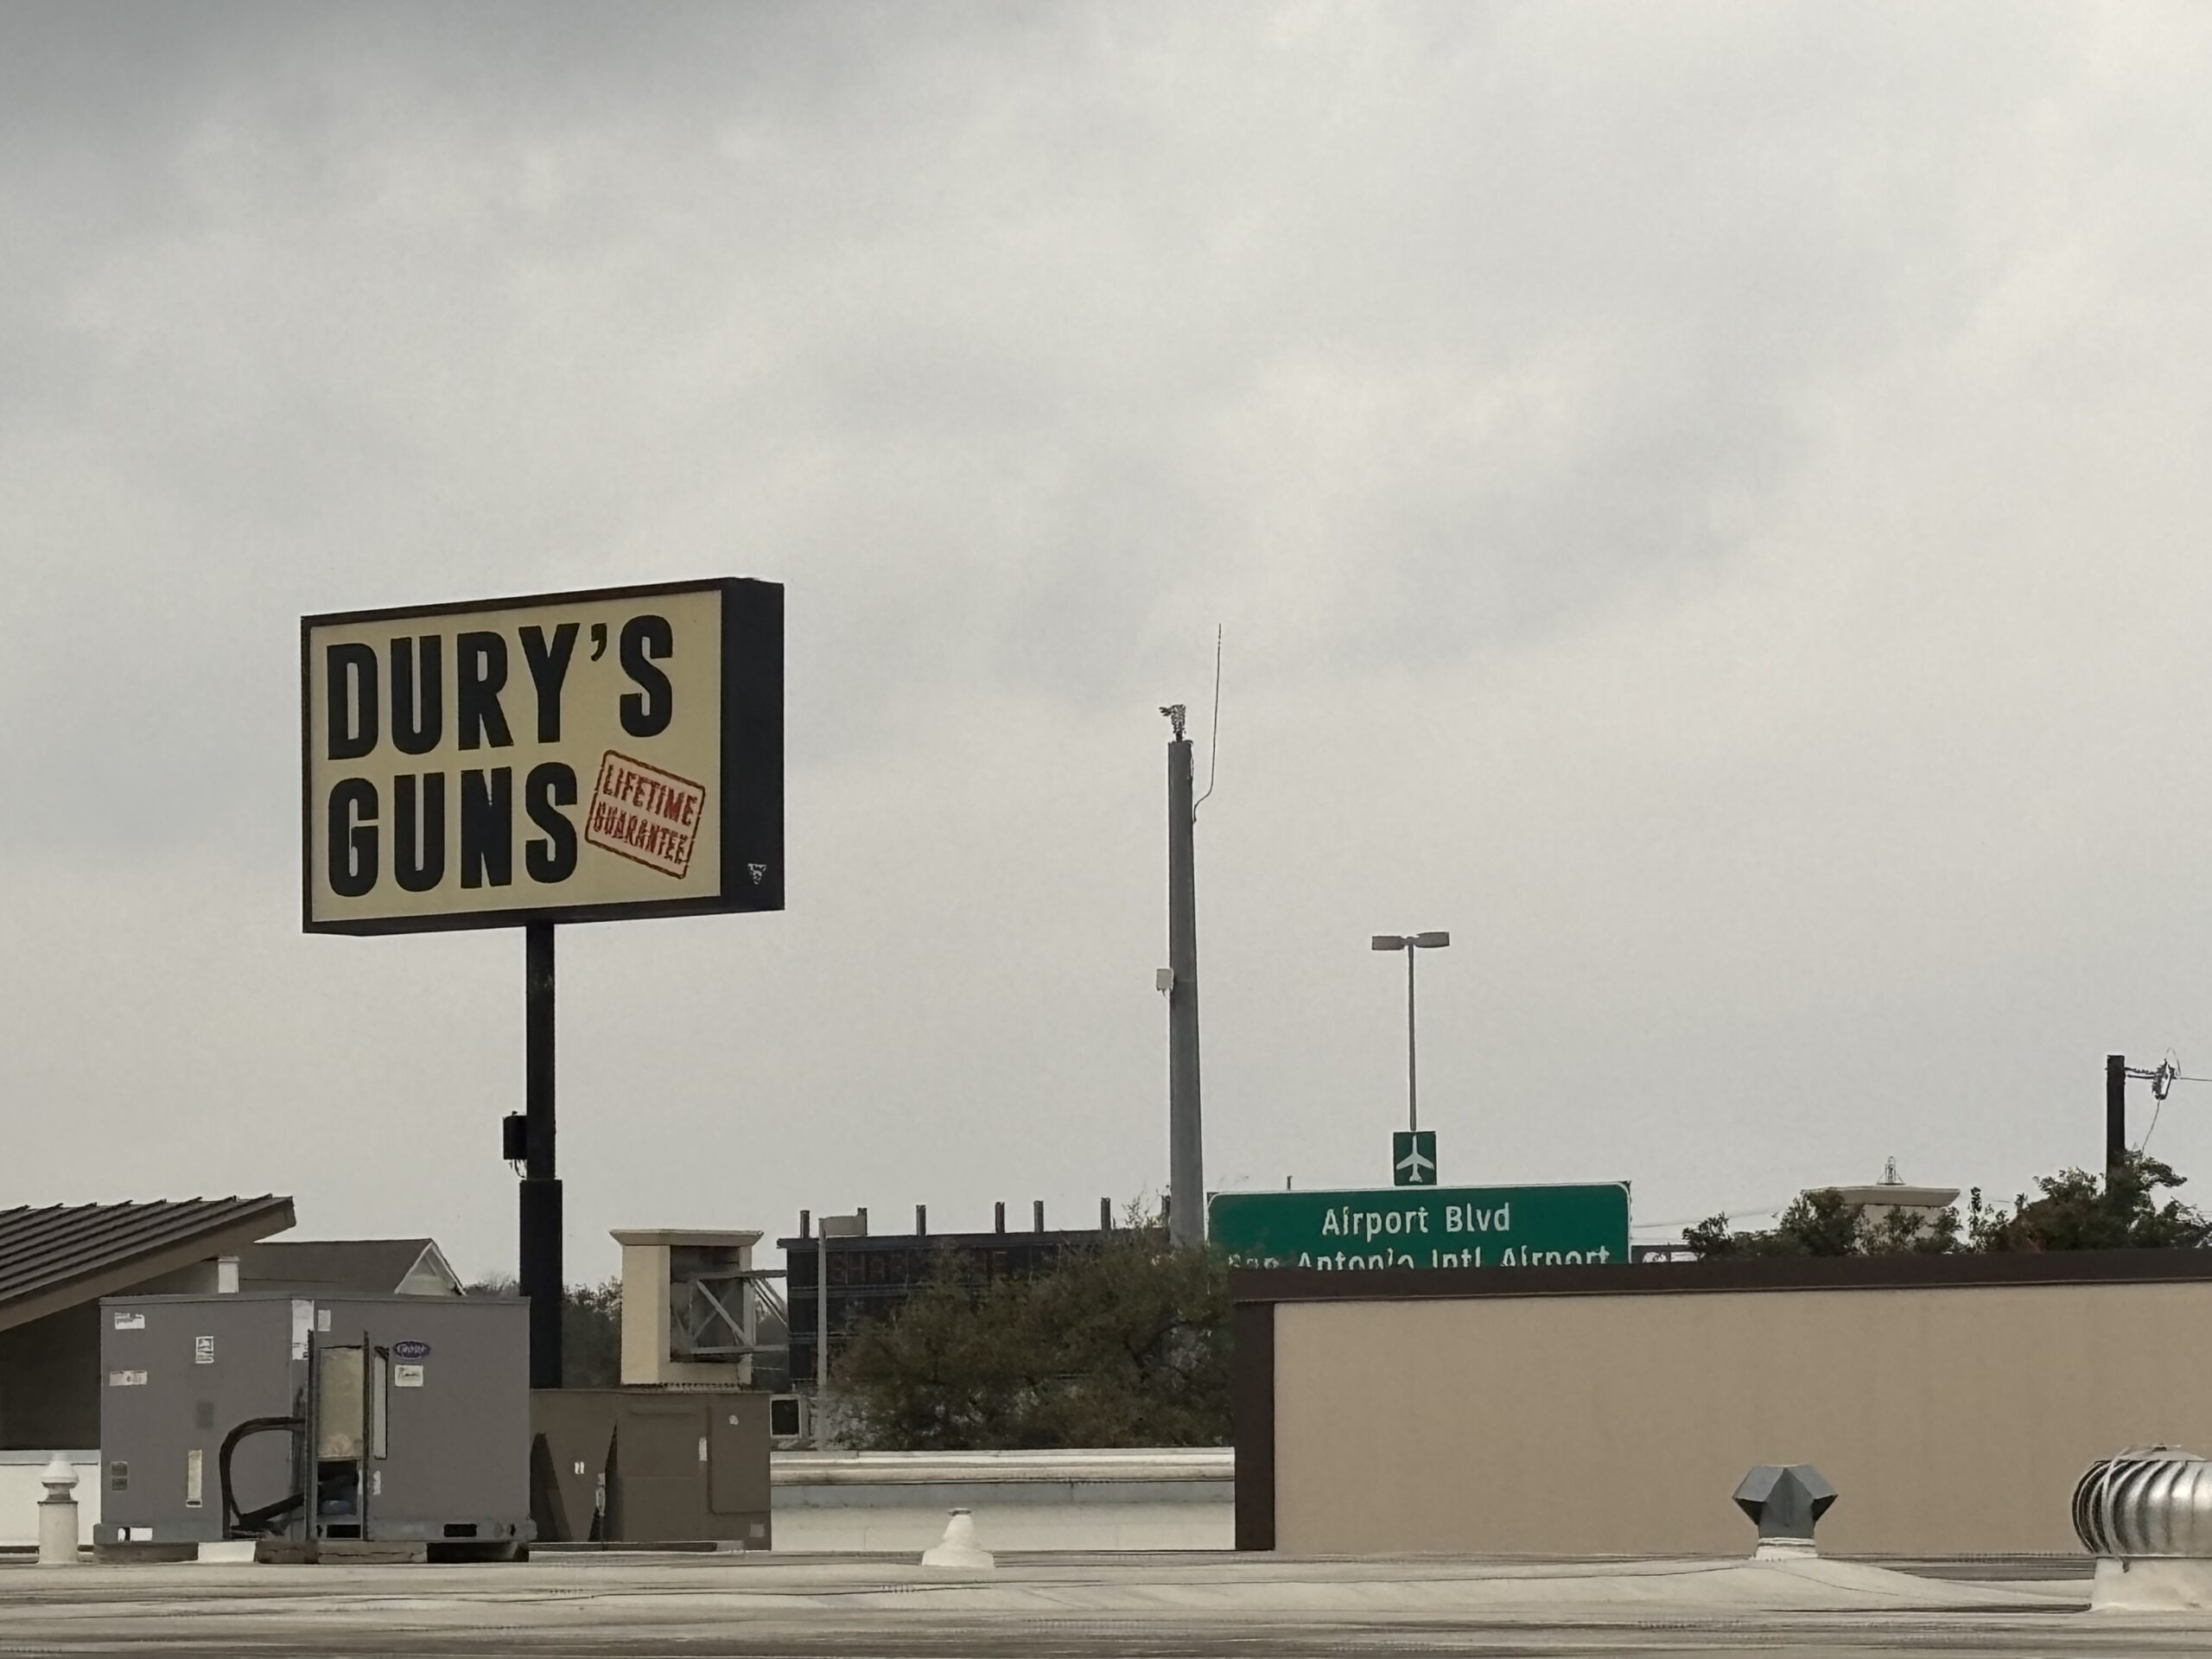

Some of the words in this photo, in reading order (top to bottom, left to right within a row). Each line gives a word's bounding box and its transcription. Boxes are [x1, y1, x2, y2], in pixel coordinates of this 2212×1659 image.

[327, 614, 673, 760] DURY'S
[603, 764, 698, 827] LIFETIME
[327, 762, 578, 897] GUNS
[593, 801, 689, 865] GUARANTEE
[1322, 1205, 1428, 1243] Airport
[1446, 1202, 1510, 1232] Blvd
